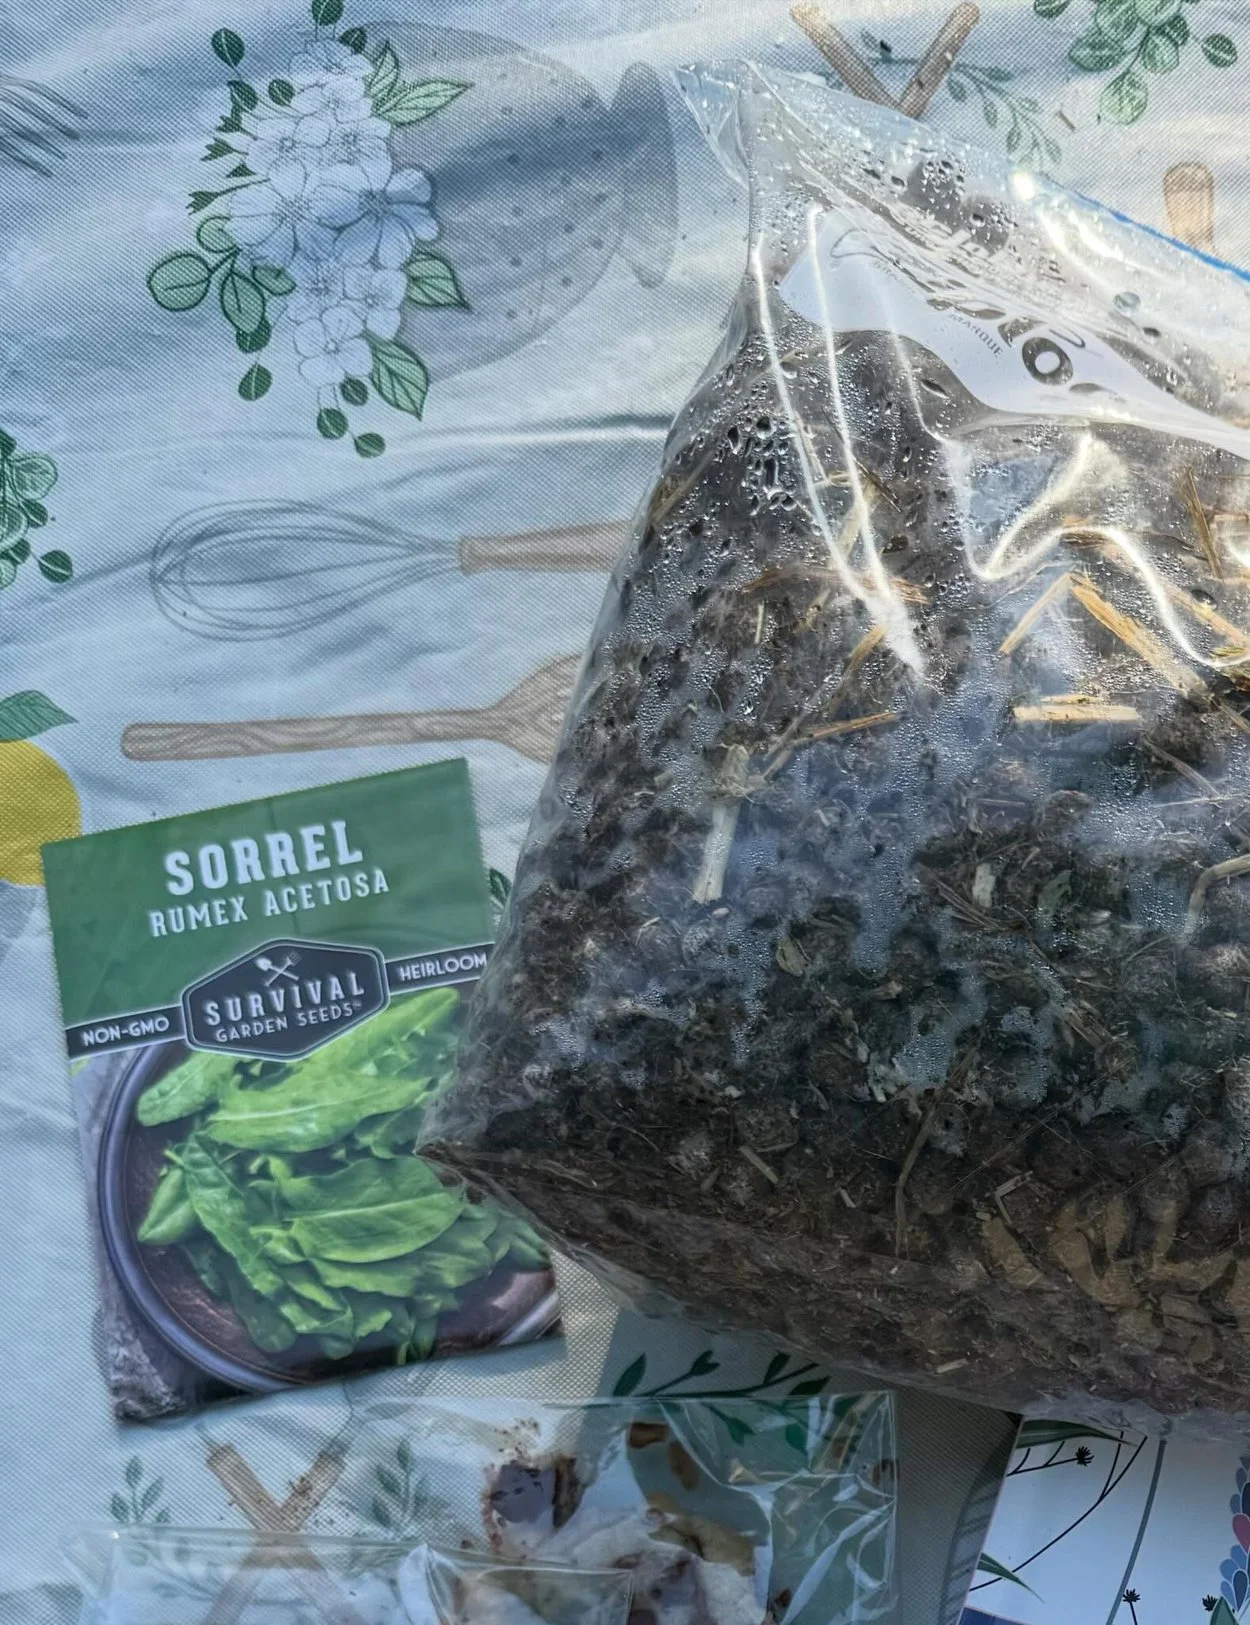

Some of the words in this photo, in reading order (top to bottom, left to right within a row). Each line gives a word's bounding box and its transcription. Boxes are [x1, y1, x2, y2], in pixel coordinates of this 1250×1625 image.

[164, 819, 364, 896] SORREL
[148, 895, 248, 938] RUMEX
[264, 867, 390, 917] ACETOSA
[398, 952, 488, 982] HEIRLOOM
[202, 971, 365, 1026] SURVIVAL
[81, 1016, 171, 1047] NON-GMO
[214, 1016, 288, 1043] GARDEN
